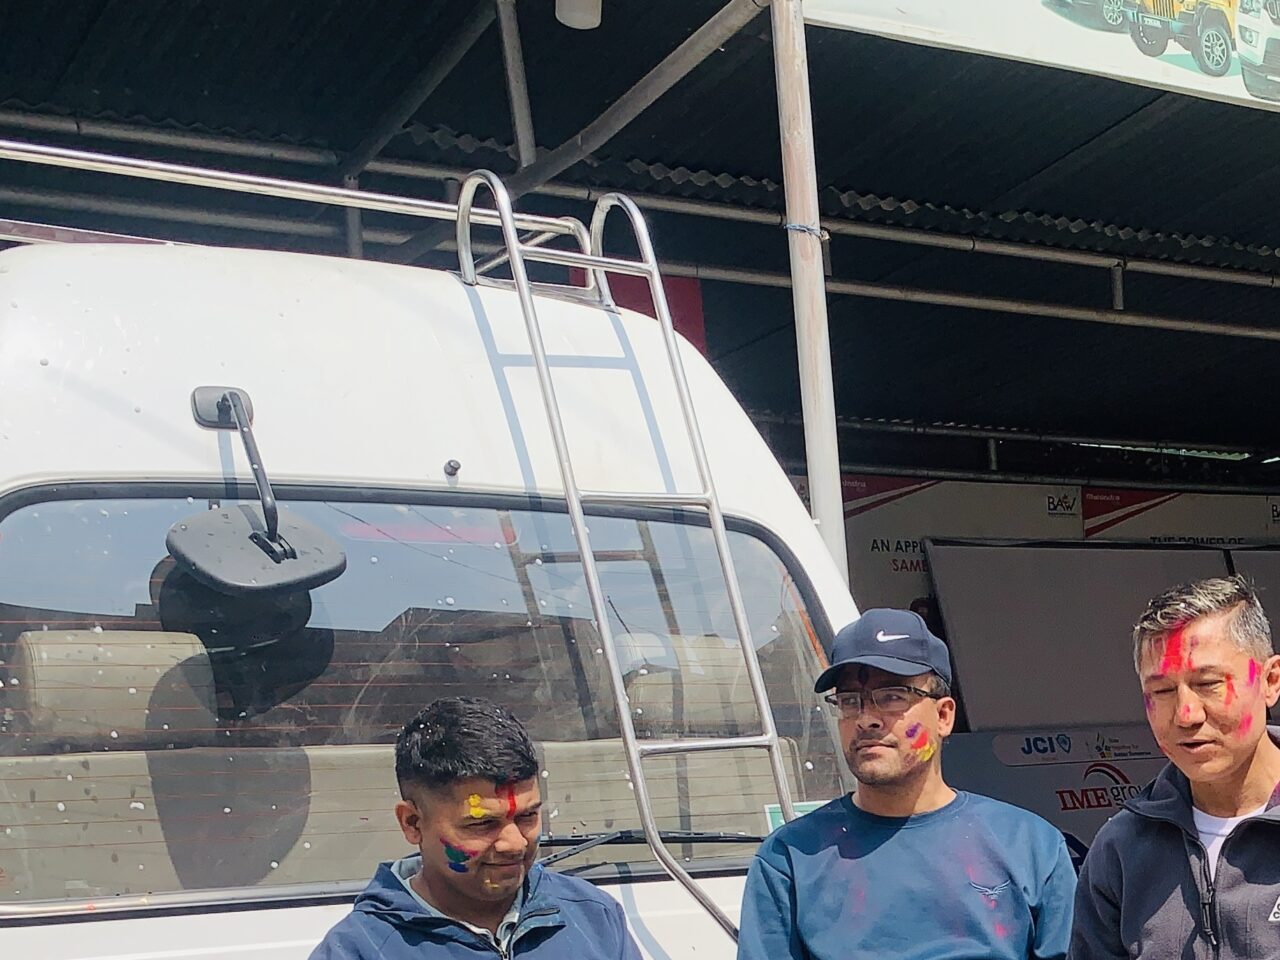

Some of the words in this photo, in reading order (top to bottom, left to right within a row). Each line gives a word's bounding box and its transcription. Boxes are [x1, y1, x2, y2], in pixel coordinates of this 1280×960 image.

[1047, 495, 1077, 512] BAW
[870, 539, 891, 552] AN
[894, 540, 927, 554] APPL
[1021, 736, 1056, 755] JCI
[1056, 788, 1112, 811] IME
